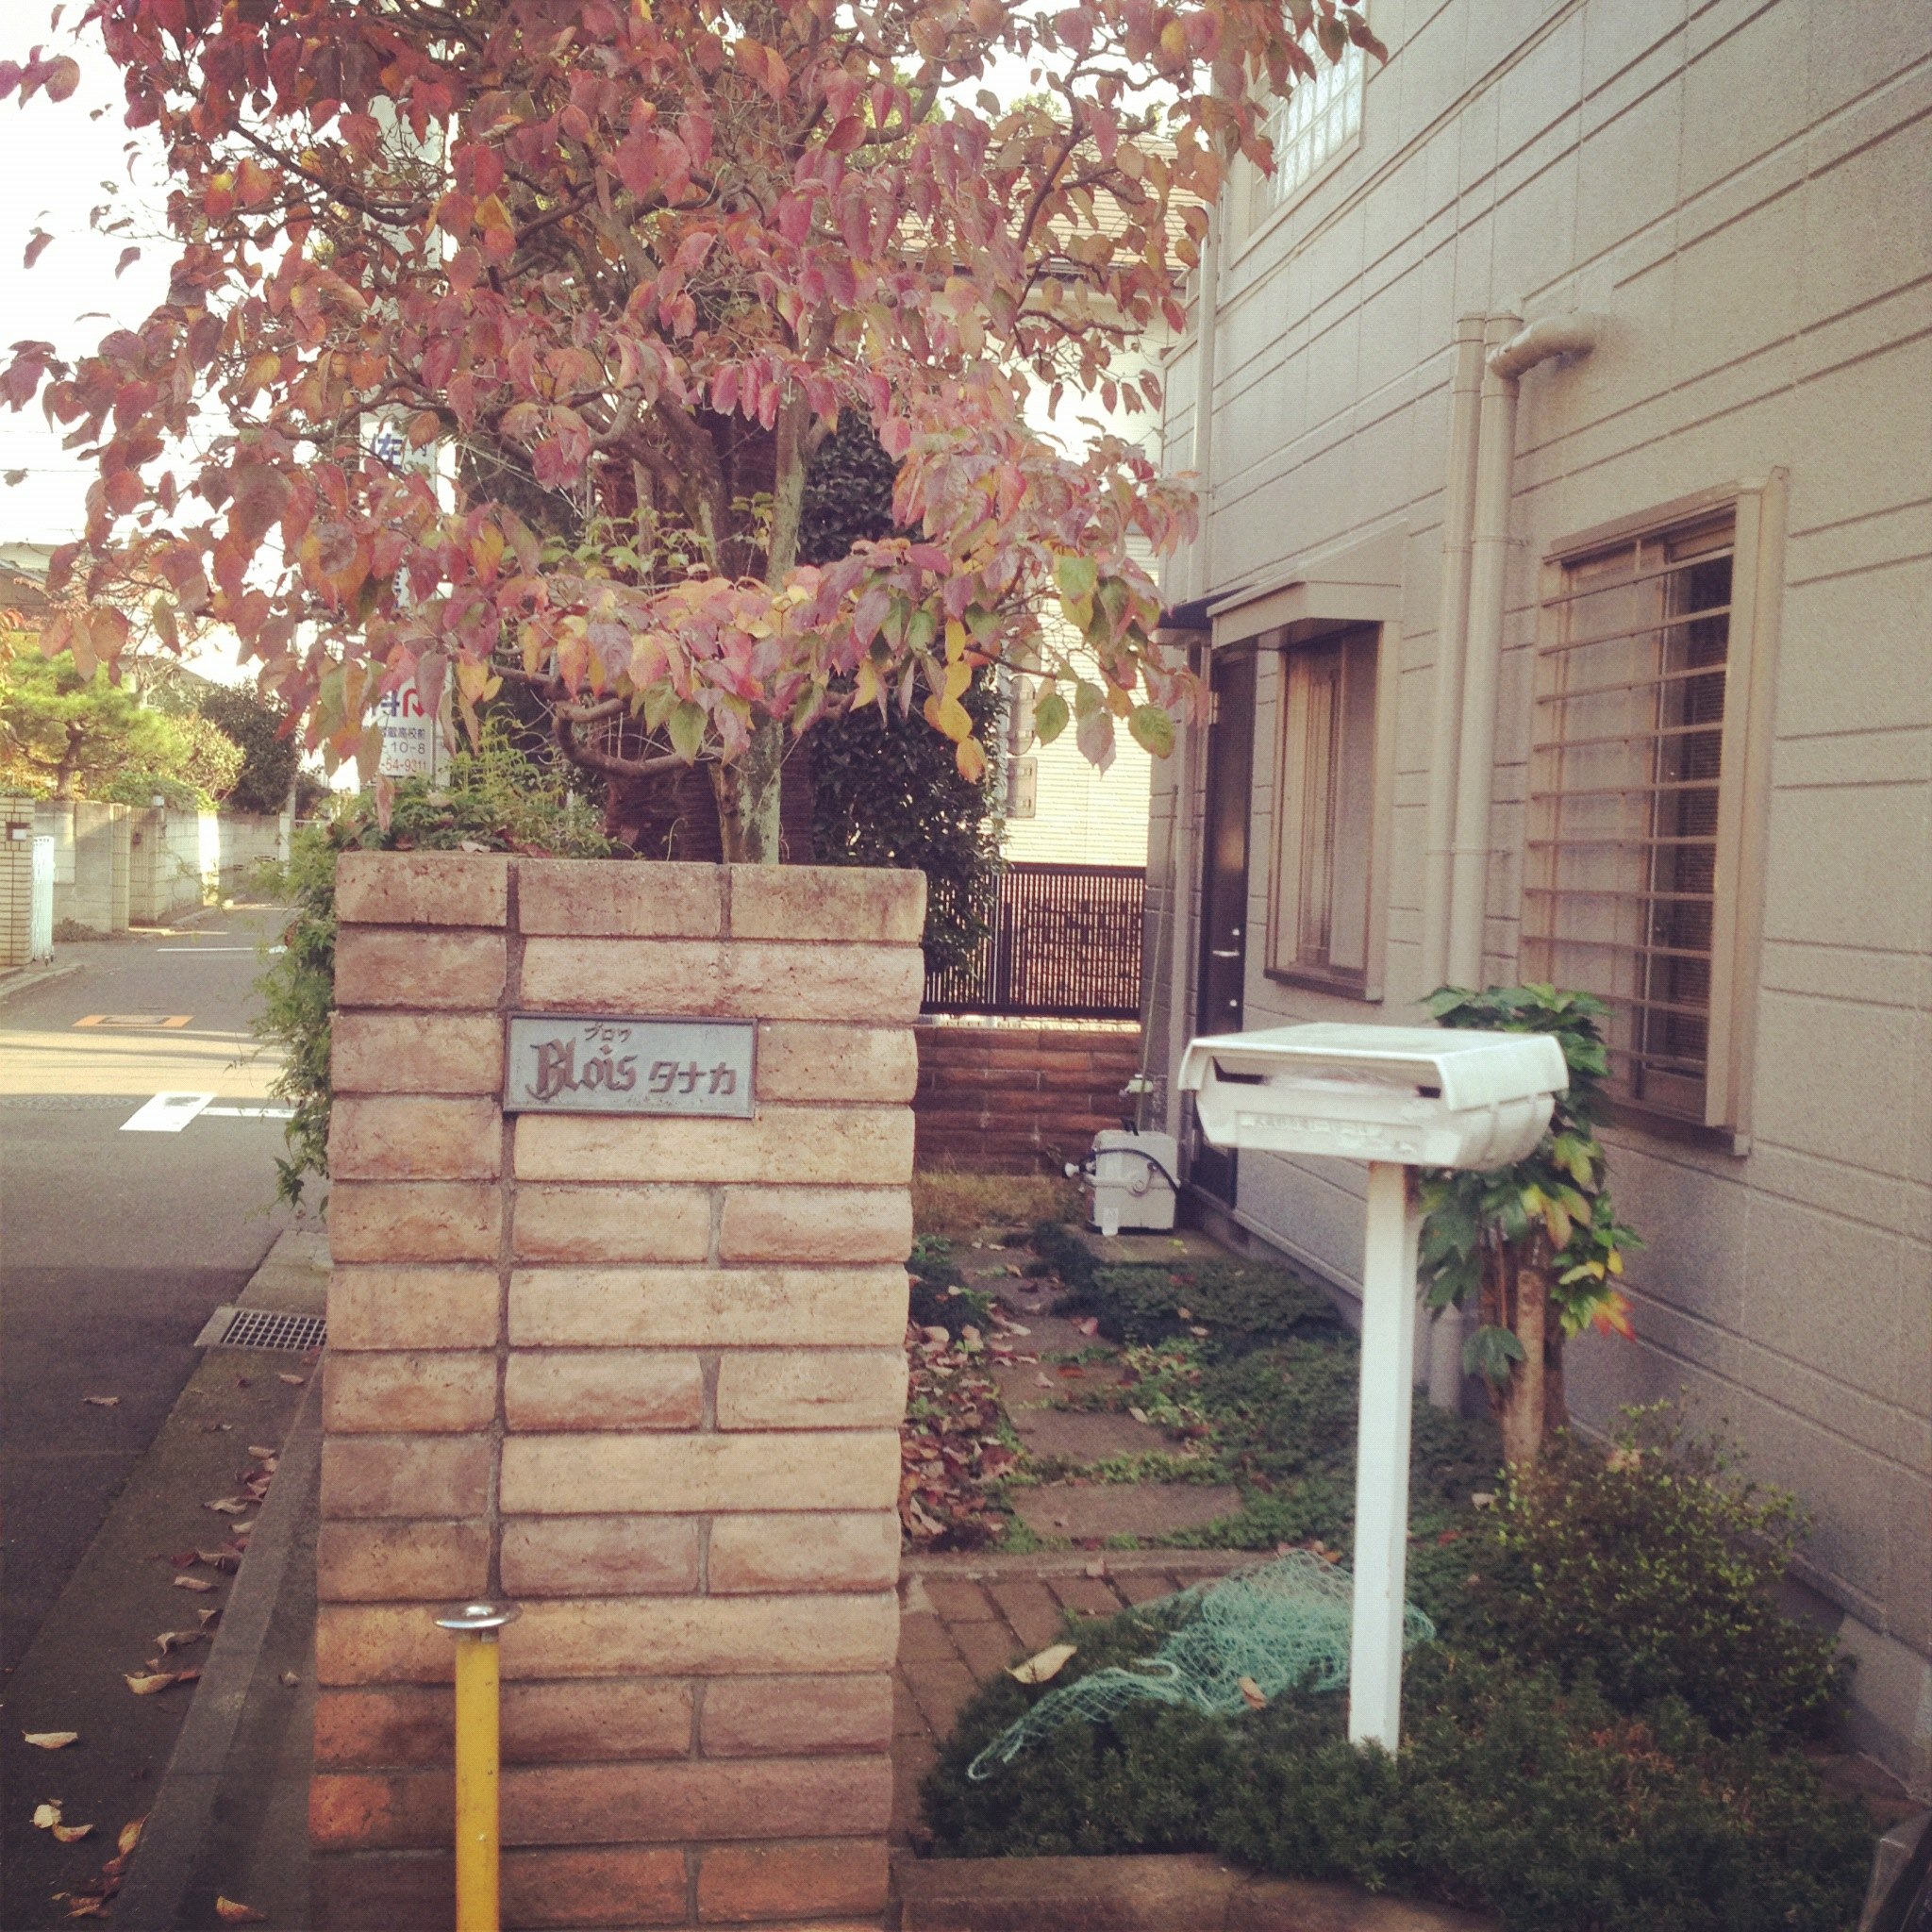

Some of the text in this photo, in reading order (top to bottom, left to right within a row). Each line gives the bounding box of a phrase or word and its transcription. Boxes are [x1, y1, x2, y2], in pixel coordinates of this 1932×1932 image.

[525, 1036, 738, 1103] Blois タナカ
